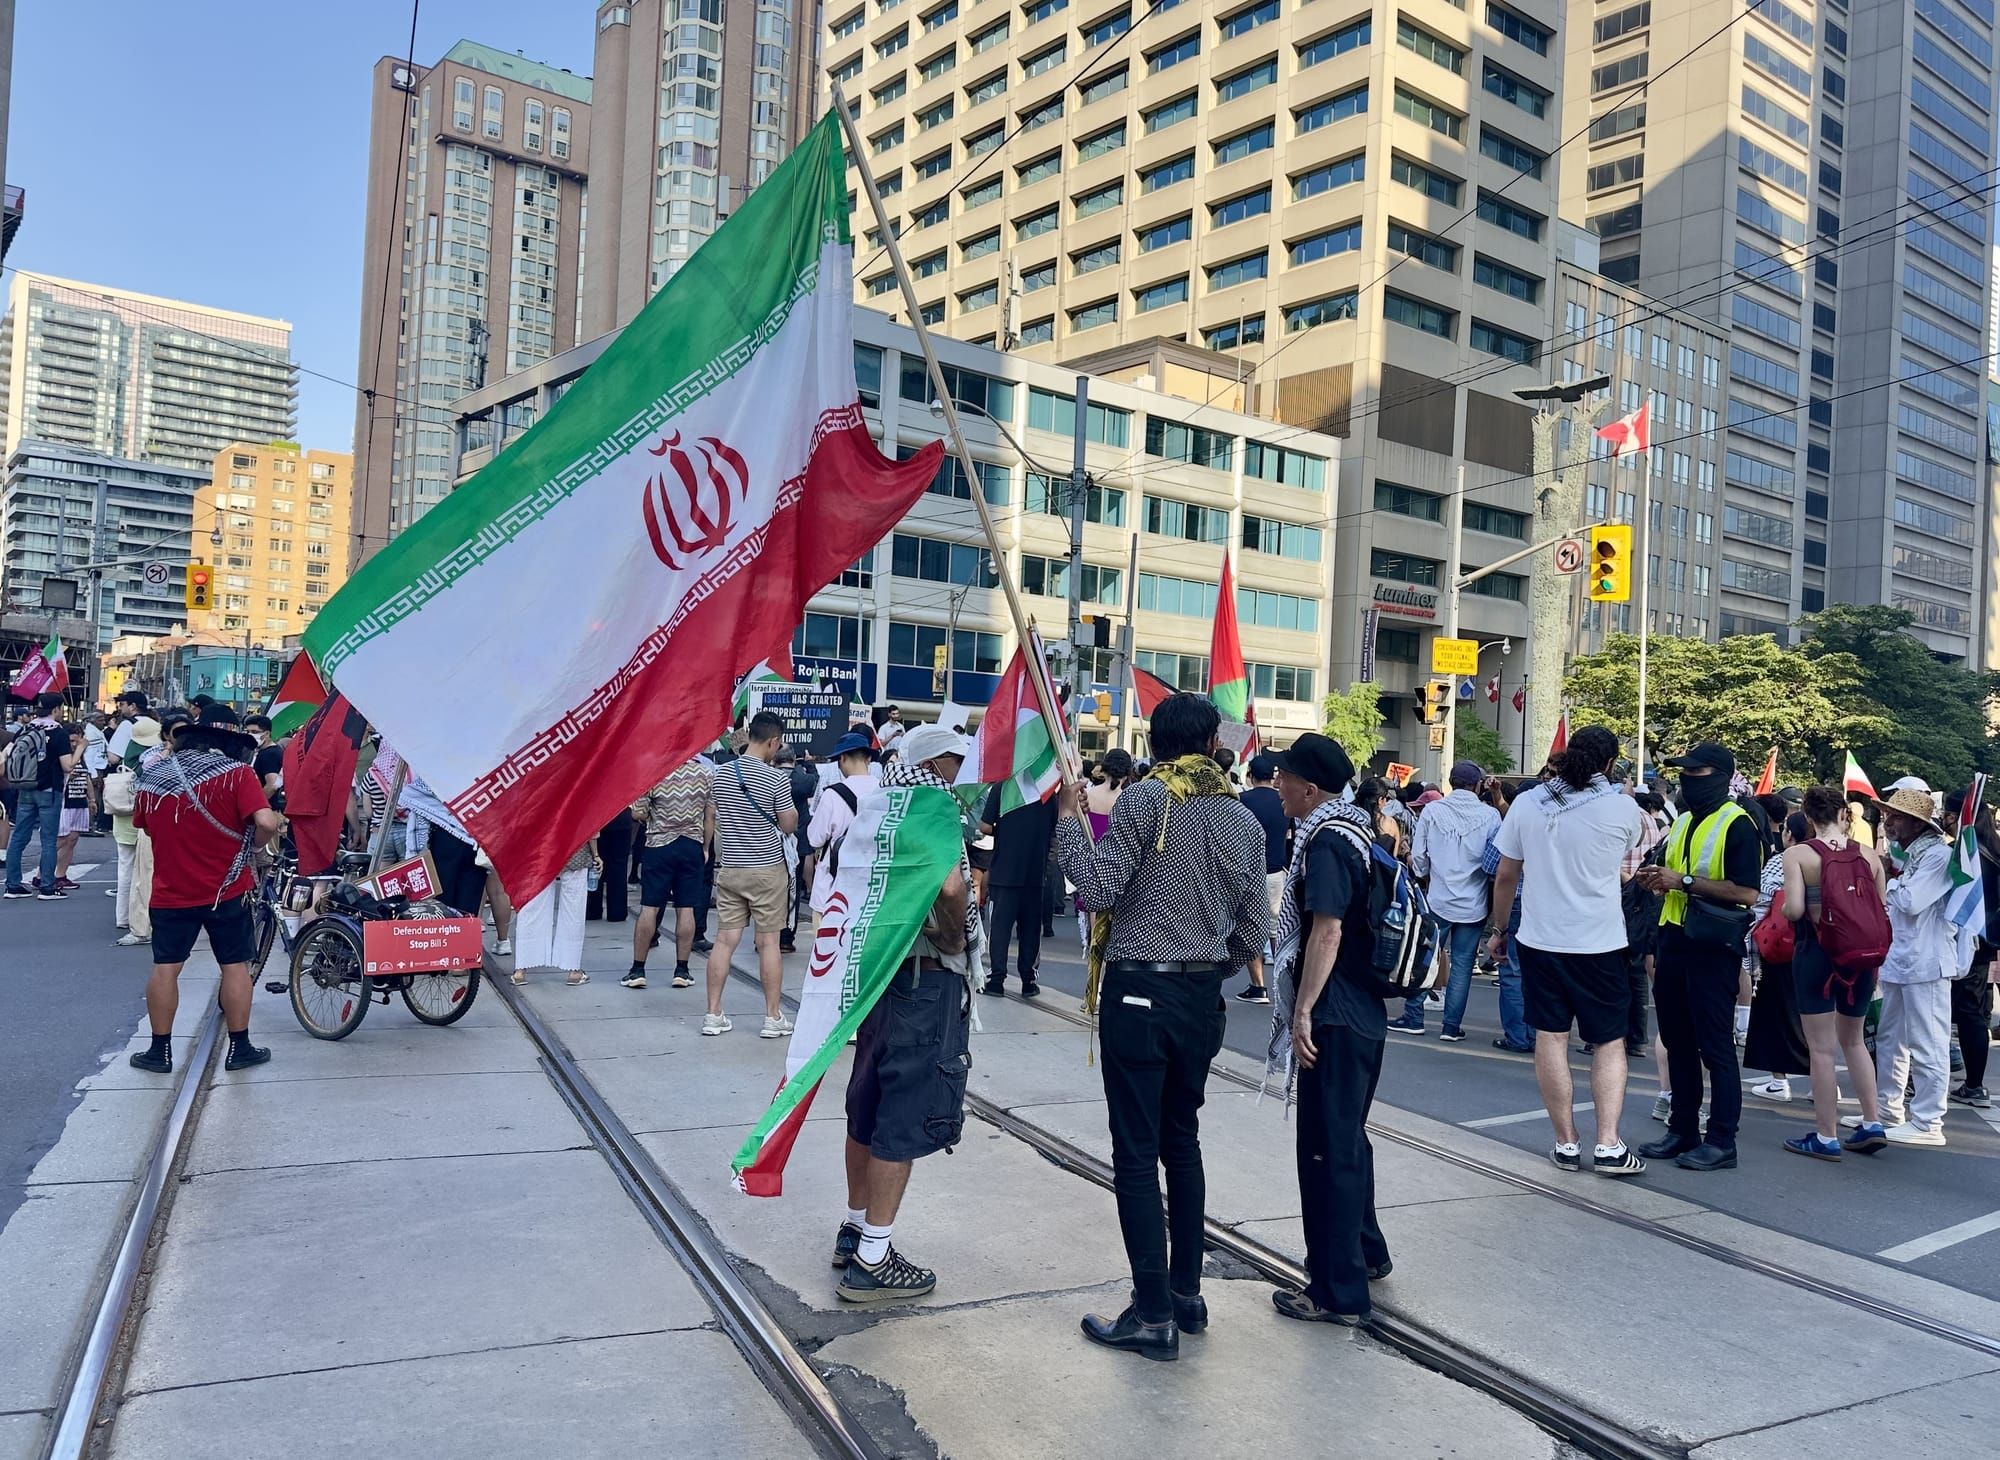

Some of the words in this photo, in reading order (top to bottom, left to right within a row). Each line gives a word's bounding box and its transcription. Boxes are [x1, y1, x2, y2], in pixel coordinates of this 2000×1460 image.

[1374, 583, 1438, 608] Luminex
[832, 667, 857, 680] Bank
[764, 694, 790, 704] ISRAEL
[792, 695, 807, 704] HAS
[810, 695, 843, 706] STARTED
[803, 708, 831, 718] ATTACK
[848, 709, 870, 718] srael"
[787, 719, 807, 729] IRAN
[810, 720, 827, 730] WAS
[782, 732, 812, 743] TIATING
[413, 883, 427, 893] WAR
[393, 926, 422, 936] Defend
[439, 925, 461, 936] rights
[410, 940, 429, 950] Stop
[430, 939, 441, 947] Bill
[443, 939, 448, 947] 5
